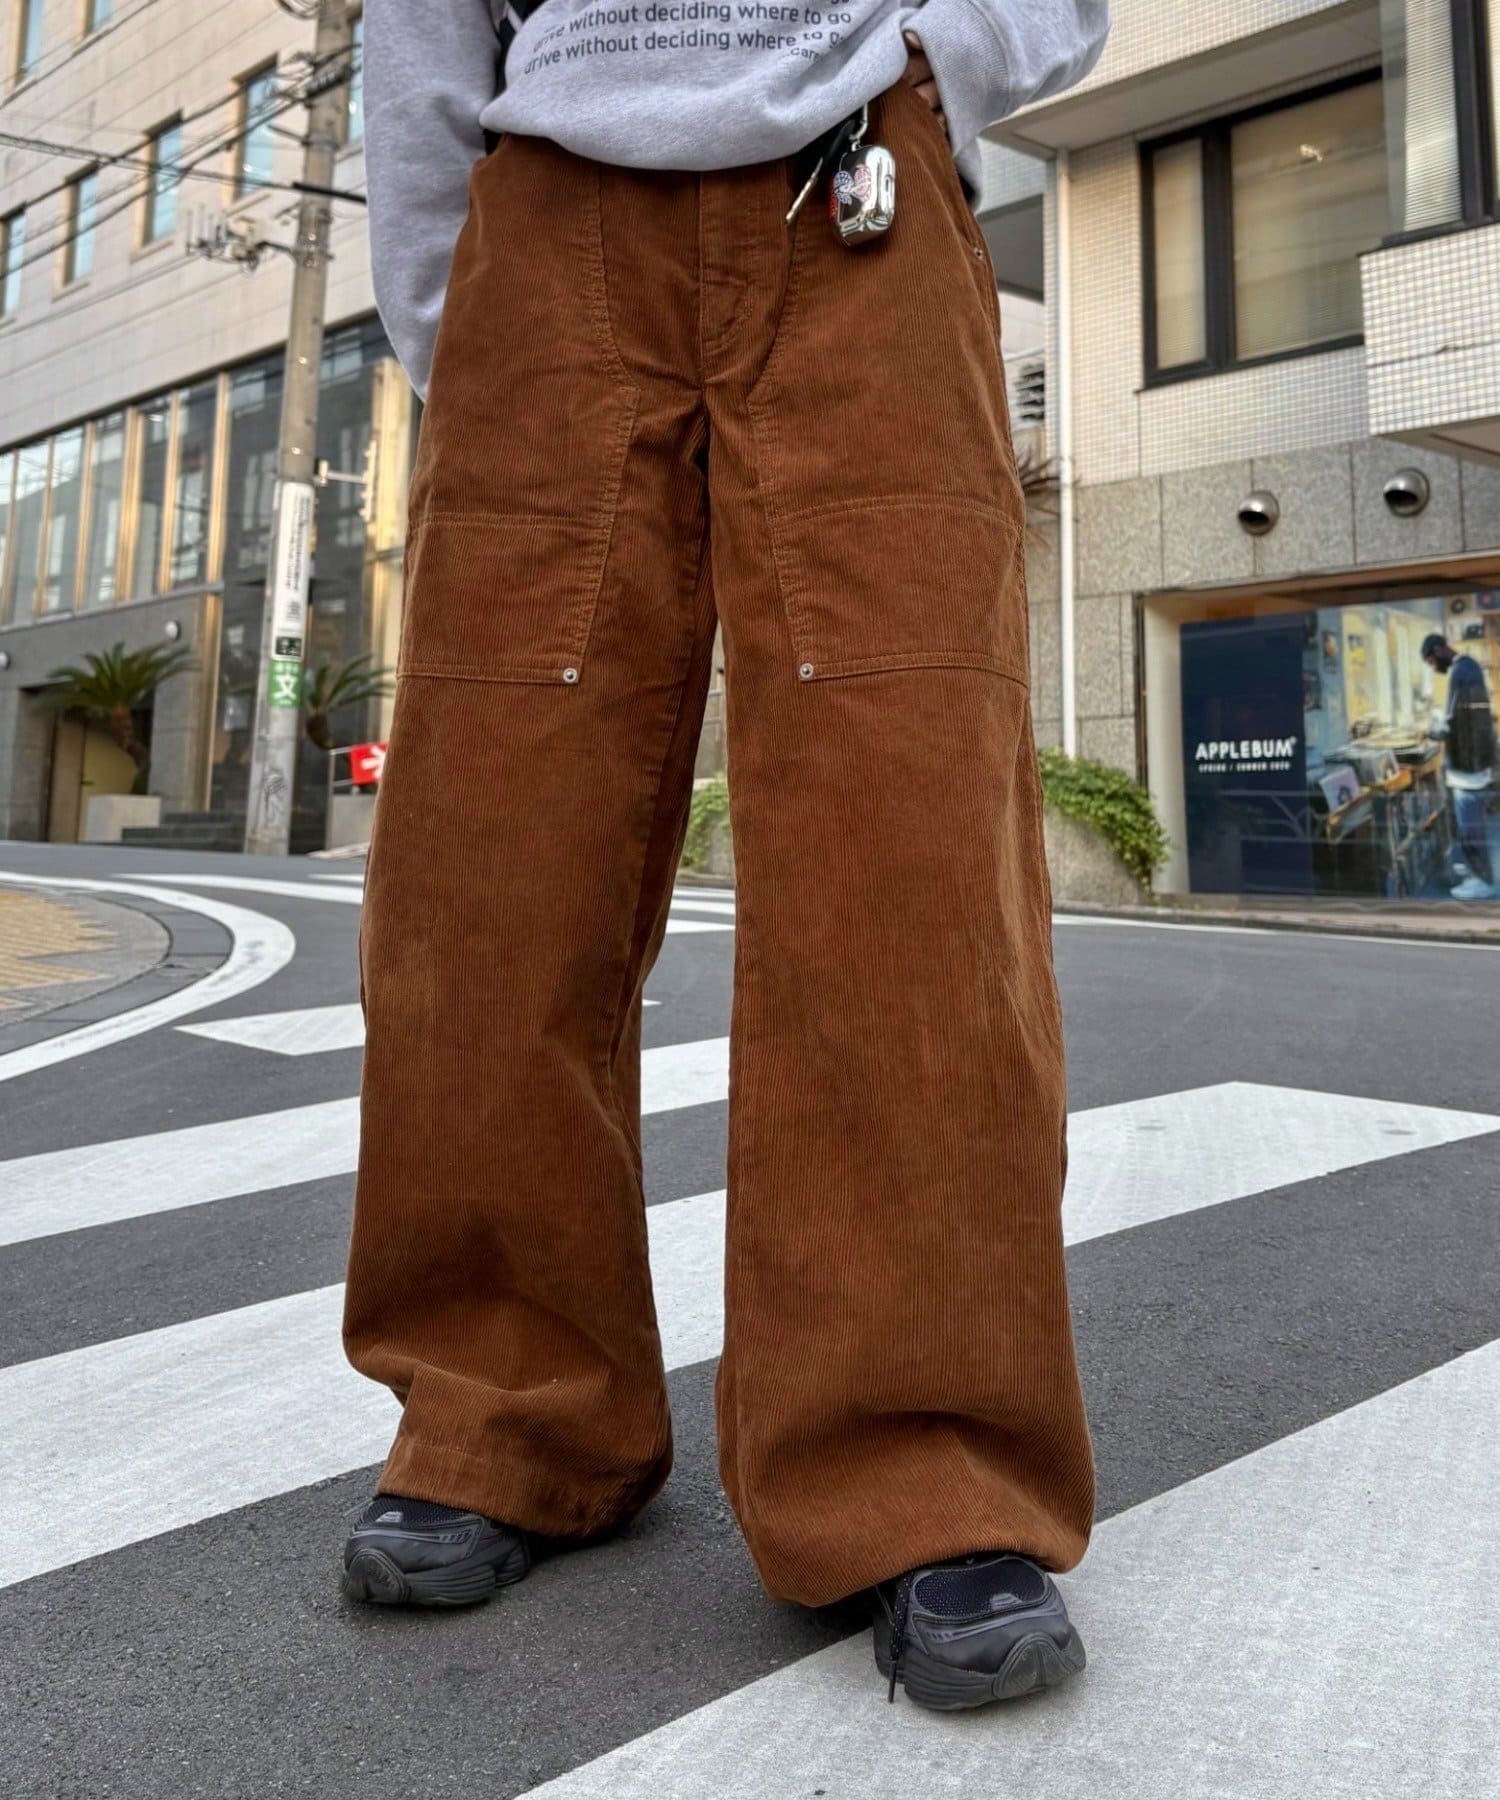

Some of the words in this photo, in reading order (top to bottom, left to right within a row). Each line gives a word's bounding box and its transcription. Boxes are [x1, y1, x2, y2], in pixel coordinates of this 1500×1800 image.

[569, 5, 638, 32] without
[645, 2, 731, 23] deciding
[738, 2, 799, 24] where
[804, 7, 821, 25] to
[828, 12, 851, 24] go
[566, 34, 638, 59] without
[644, 29, 730, 51] deciding
[737, 29, 797, 50] where
[803, 31, 823, 41] to
[1195, 738, 1294, 760] APPLEBUM
